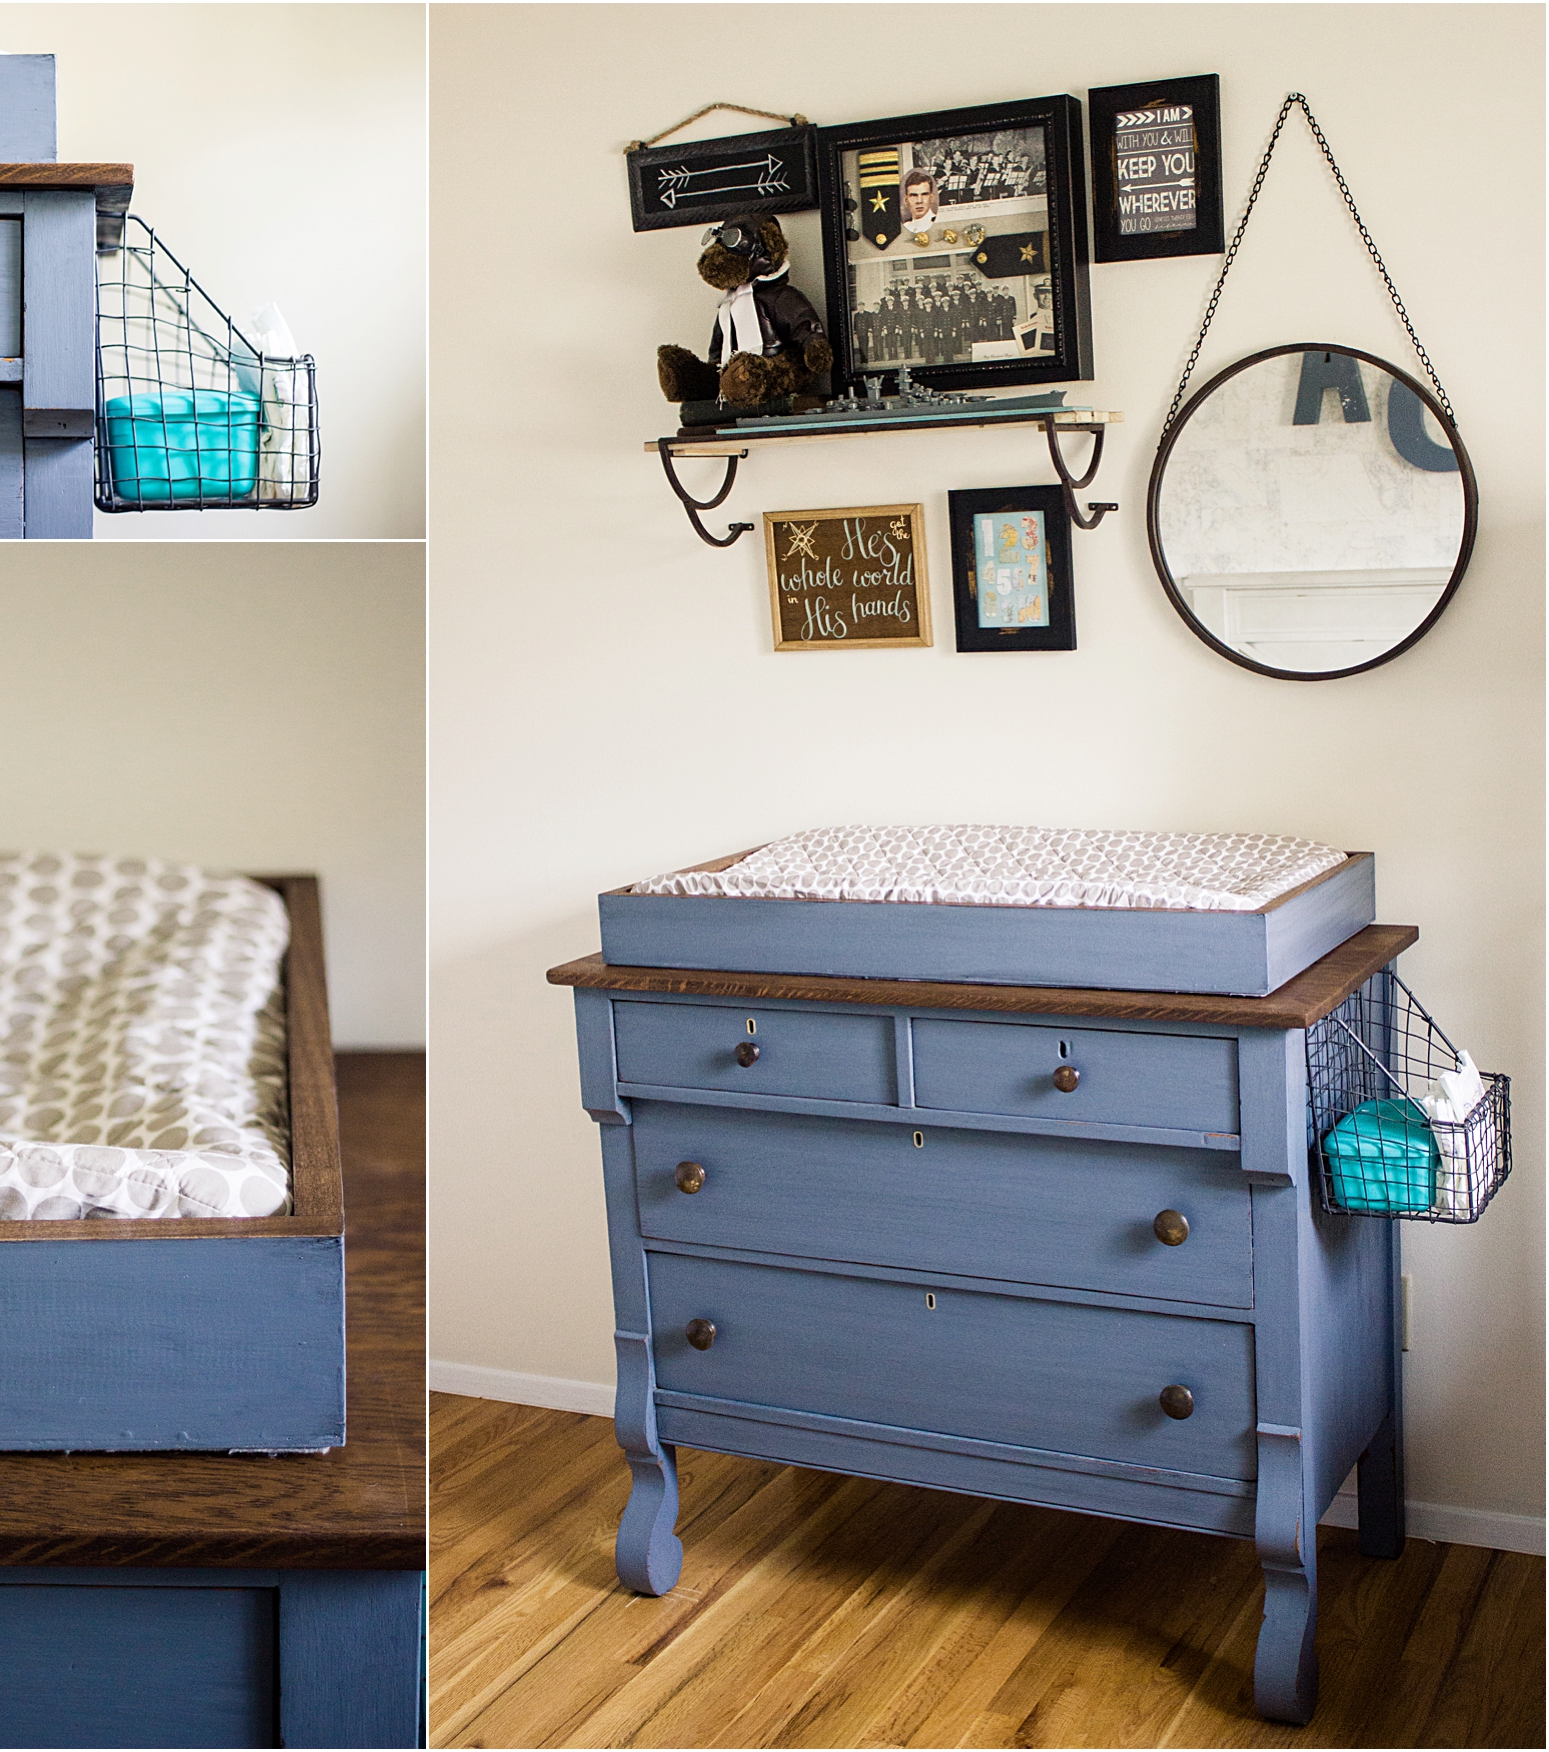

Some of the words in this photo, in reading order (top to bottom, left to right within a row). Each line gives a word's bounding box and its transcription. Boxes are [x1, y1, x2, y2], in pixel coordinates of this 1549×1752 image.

[1156, 109, 1161, 123] I
[1163, 107, 1180, 122] AM
[1116, 134, 1139, 149] WITH
[1142, 132, 1159, 147] YOU
[1160, 130, 1172, 145] &
[1117, 155, 1157, 180] KEEP
[1161, 152, 1195, 176] YOU
[1118, 189, 1196, 215] WHEREVER
[1120, 218, 1137, 232] YOU
[1140, 217, 1152, 231] GO
[890, 515, 907, 536] got
[896, 528, 911, 540] the
[841, 517, 897, 567] He's
[981, 519, 994, 557] 1
[998, 523, 1019, 564] 2
[1020, 516, 1038, 551] 3
[781, 556, 844, 591] whole
[853, 552, 914, 587] world
[996, 568, 1012, 596] 5
[1025, 554, 1040, 585] 7
[787, 595, 799, 604] in
[801, 596, 847, 640] His
[852, 590, 911, 623] hands
